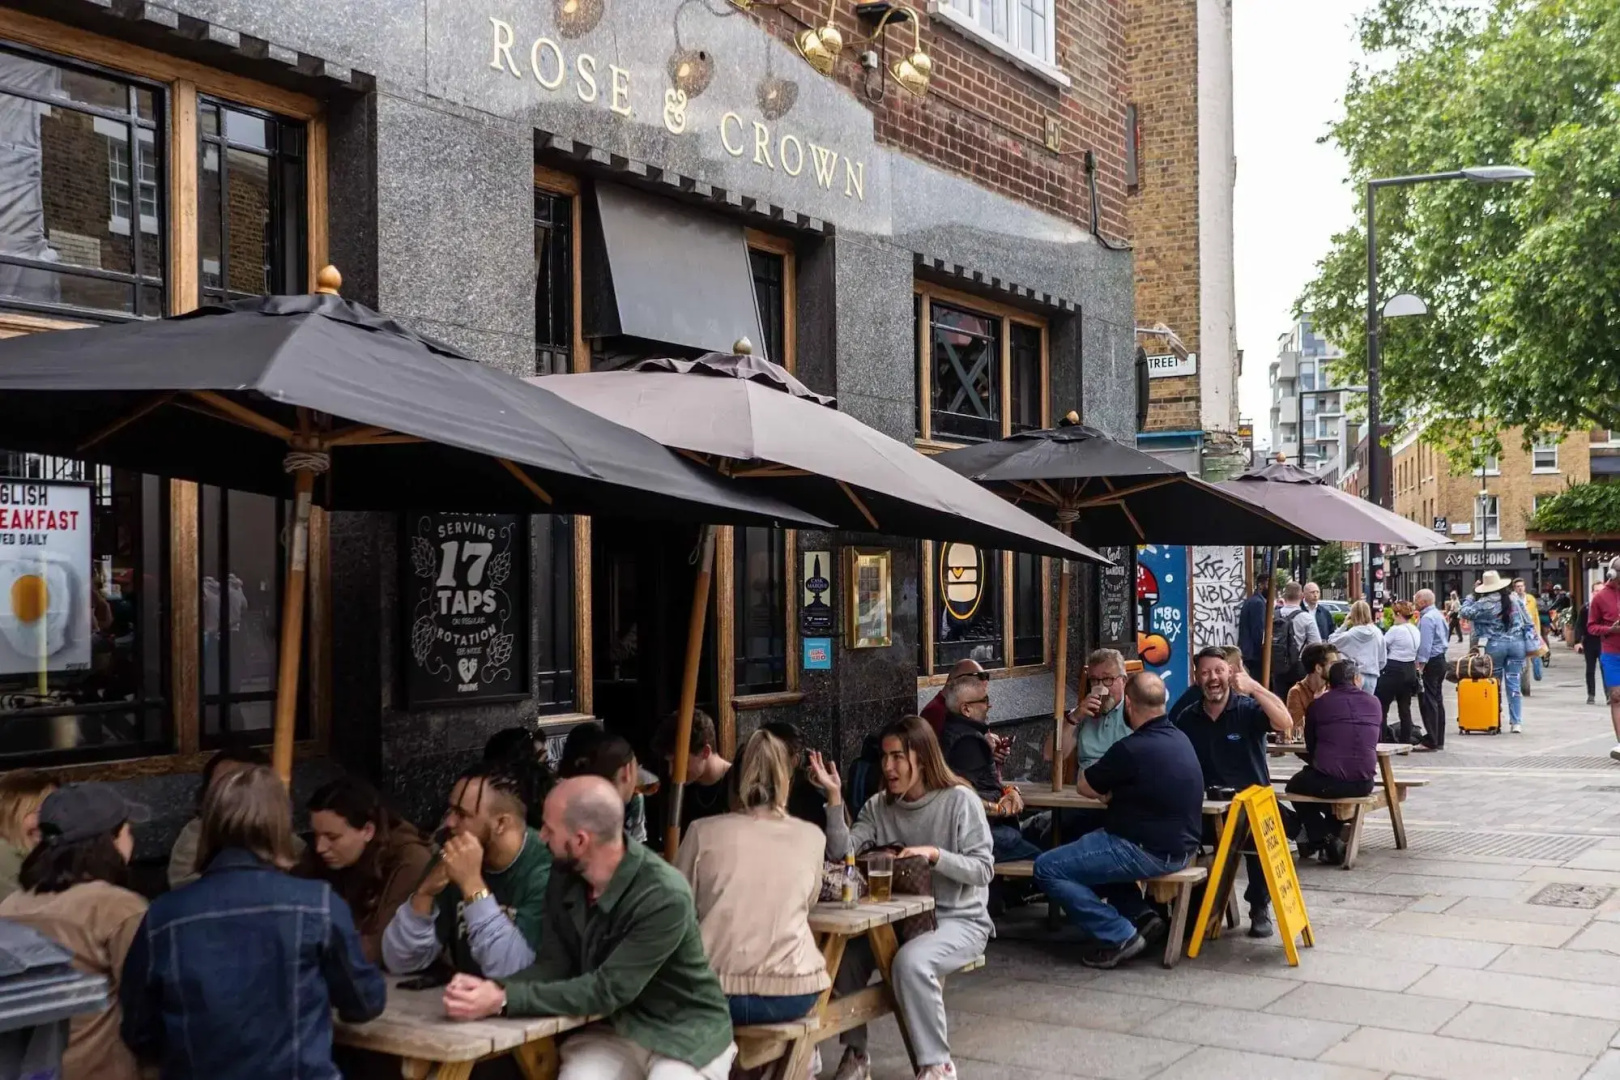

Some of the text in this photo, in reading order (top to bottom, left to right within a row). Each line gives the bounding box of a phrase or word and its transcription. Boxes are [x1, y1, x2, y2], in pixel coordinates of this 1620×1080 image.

[488, 17, 865, 201] ROSE & CROWN
[1148, 357, 1178, 369] TREET
[0, 533, 48, 546] ED DAILY
[438, 521, 496, 540] SERVING
[436, 541, 493, 587] 17
[1464, 552, 1511, 565] NELSONS
[437, 589, 497, 615] TAPS
[1154, 606, 1181, 621] 1980
[437, 624, 497, 646] ROTATION
